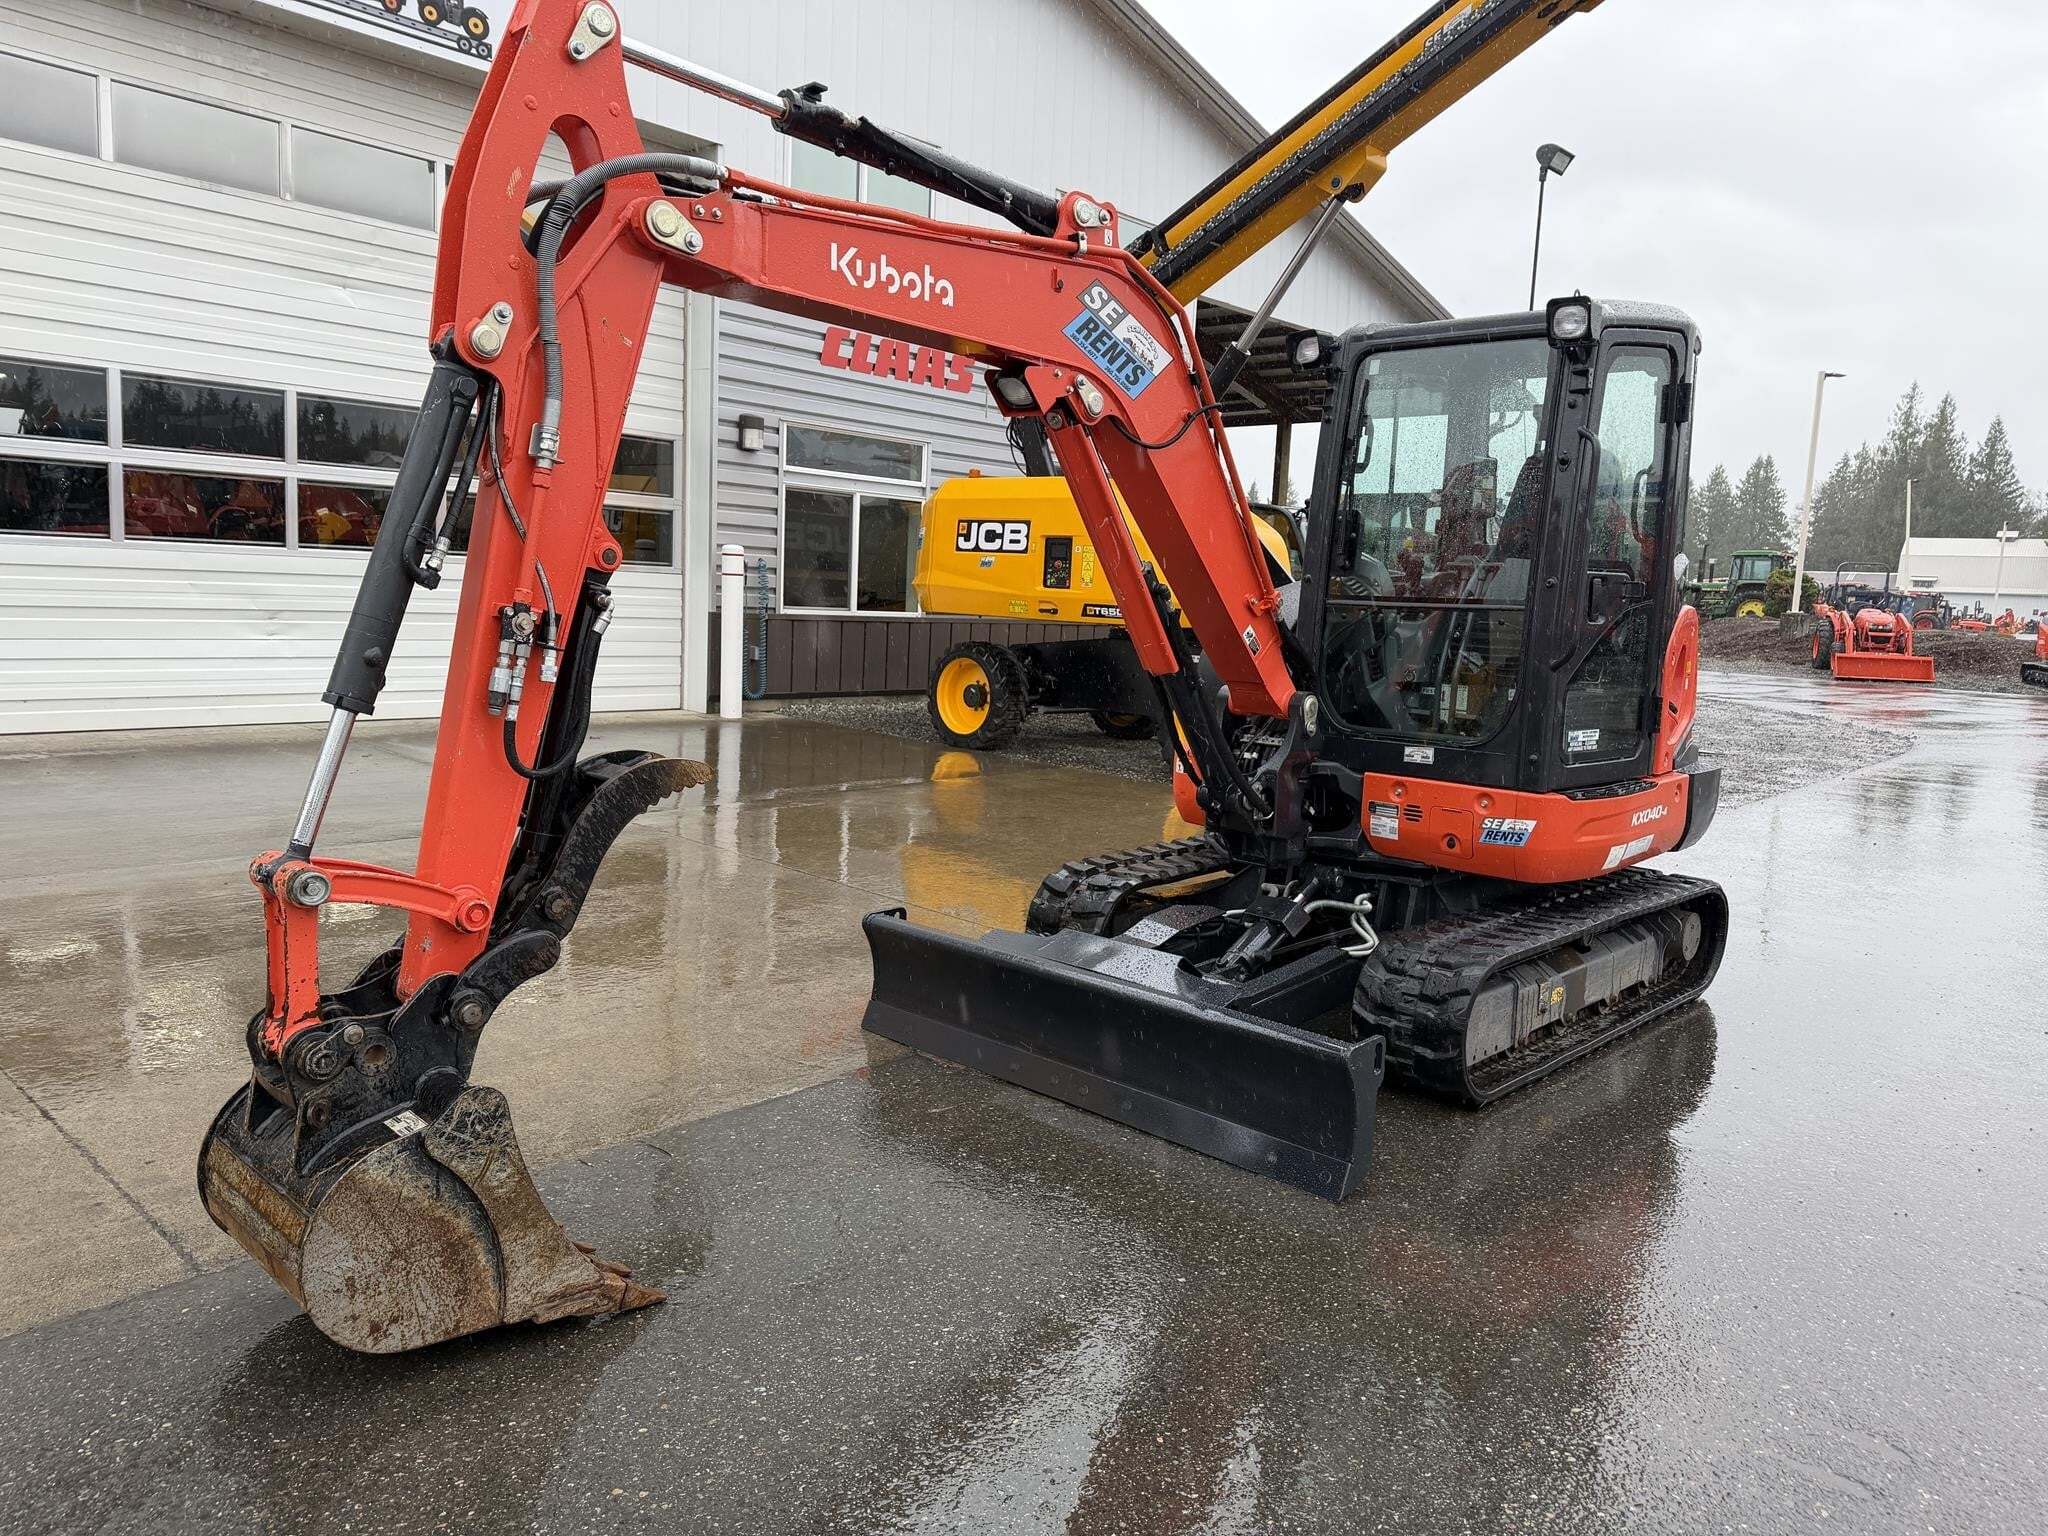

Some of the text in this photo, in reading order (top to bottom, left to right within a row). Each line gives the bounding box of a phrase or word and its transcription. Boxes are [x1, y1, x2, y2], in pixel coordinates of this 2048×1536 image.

[830, 242, 954, 307] Kubota
[1084, 286, 1124, 326] SE
[820, 326, 976, 394] CLAAS
[1075, 317, 1146, 387] RENTS
[957, 522, 1028, 551] JCB
[1482, 818, 1502, 829] SE
[1484, 830, 1525, 843] RENTS
